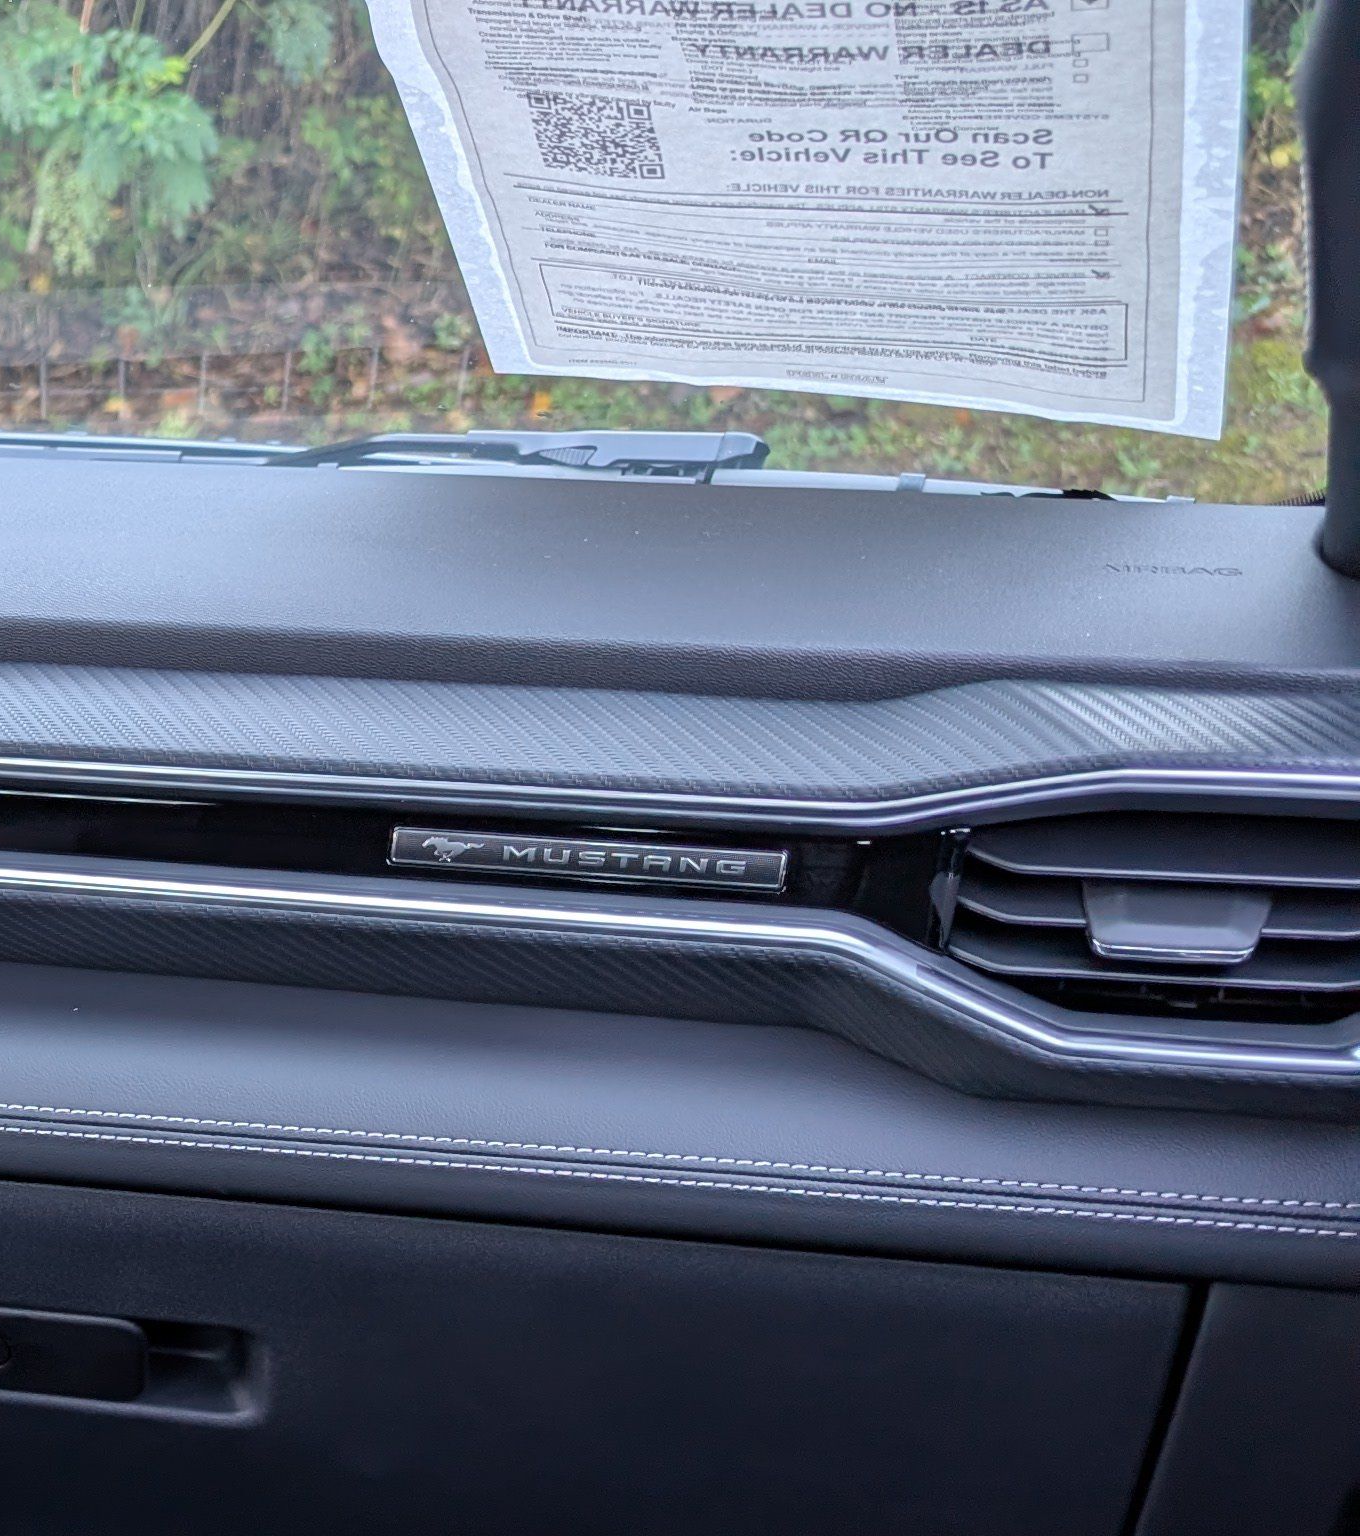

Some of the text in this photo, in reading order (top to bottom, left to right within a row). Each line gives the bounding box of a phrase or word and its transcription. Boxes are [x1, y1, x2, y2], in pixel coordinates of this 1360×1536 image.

[468, 7, 527, 18] Transmission
[689, 105, 727, 115] Air Bags
[501, 844, 748, 877] MUSTANG
